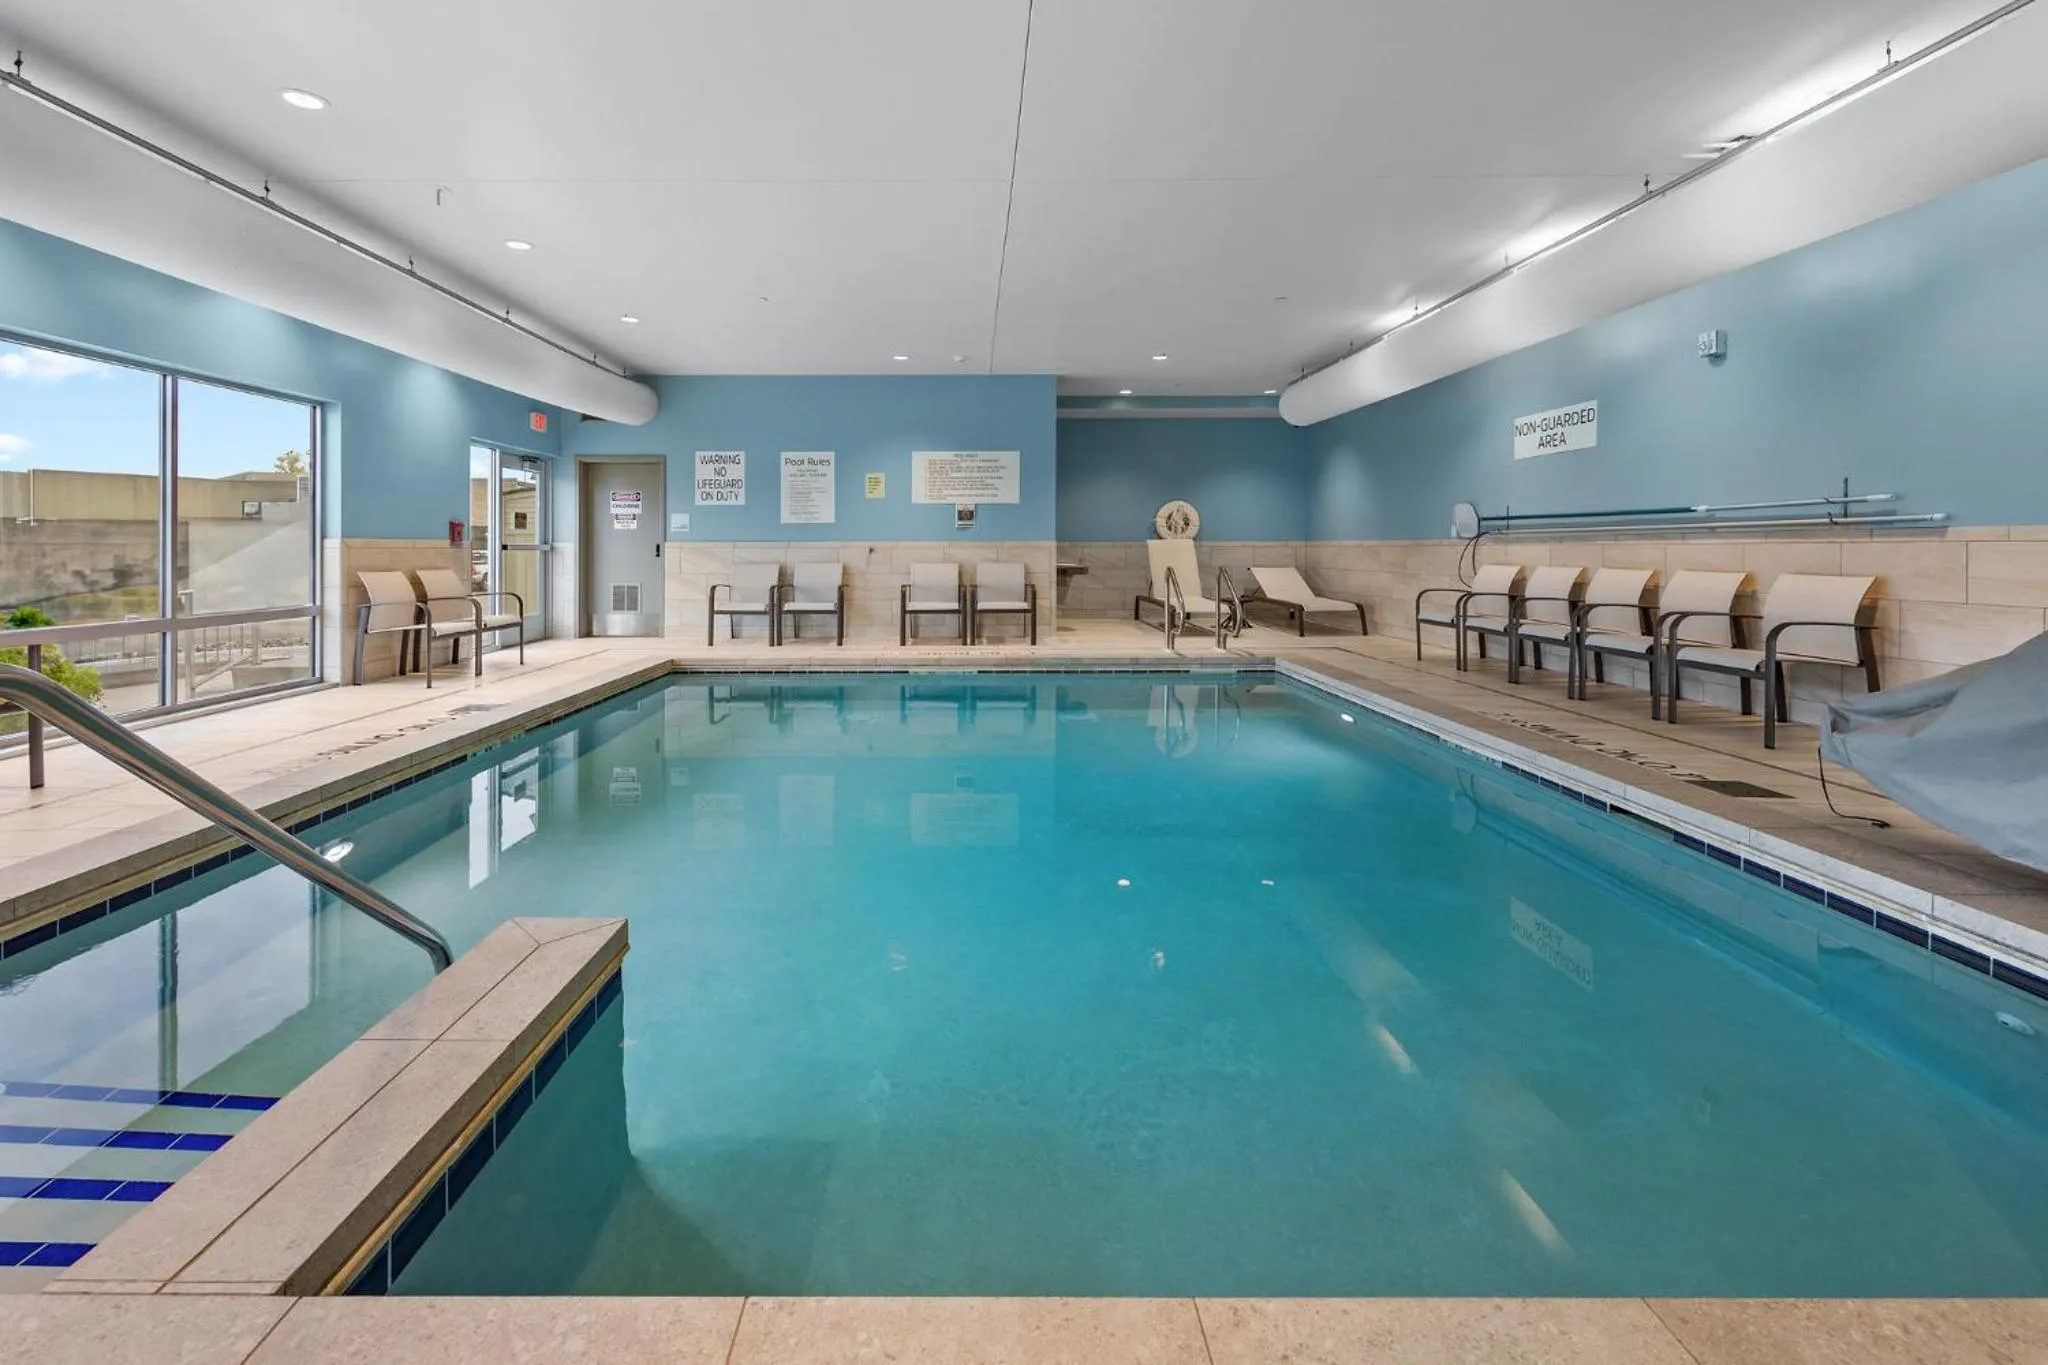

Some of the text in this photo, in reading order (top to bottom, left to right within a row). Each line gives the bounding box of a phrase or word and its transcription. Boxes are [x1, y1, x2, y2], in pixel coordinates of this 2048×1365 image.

[1515, 407, 1596, 438] NON-GUARDED
[1537, 431, 1567, 449] AREA
[700, 454, 741, 465] WARNING
[785, 457, 831, 467] Pool Rules
[714, 466, 727, 477] NO
[697, 478, 743, 489] LIFEGUARD
[701, 490, 739, 501] ON DUTY
